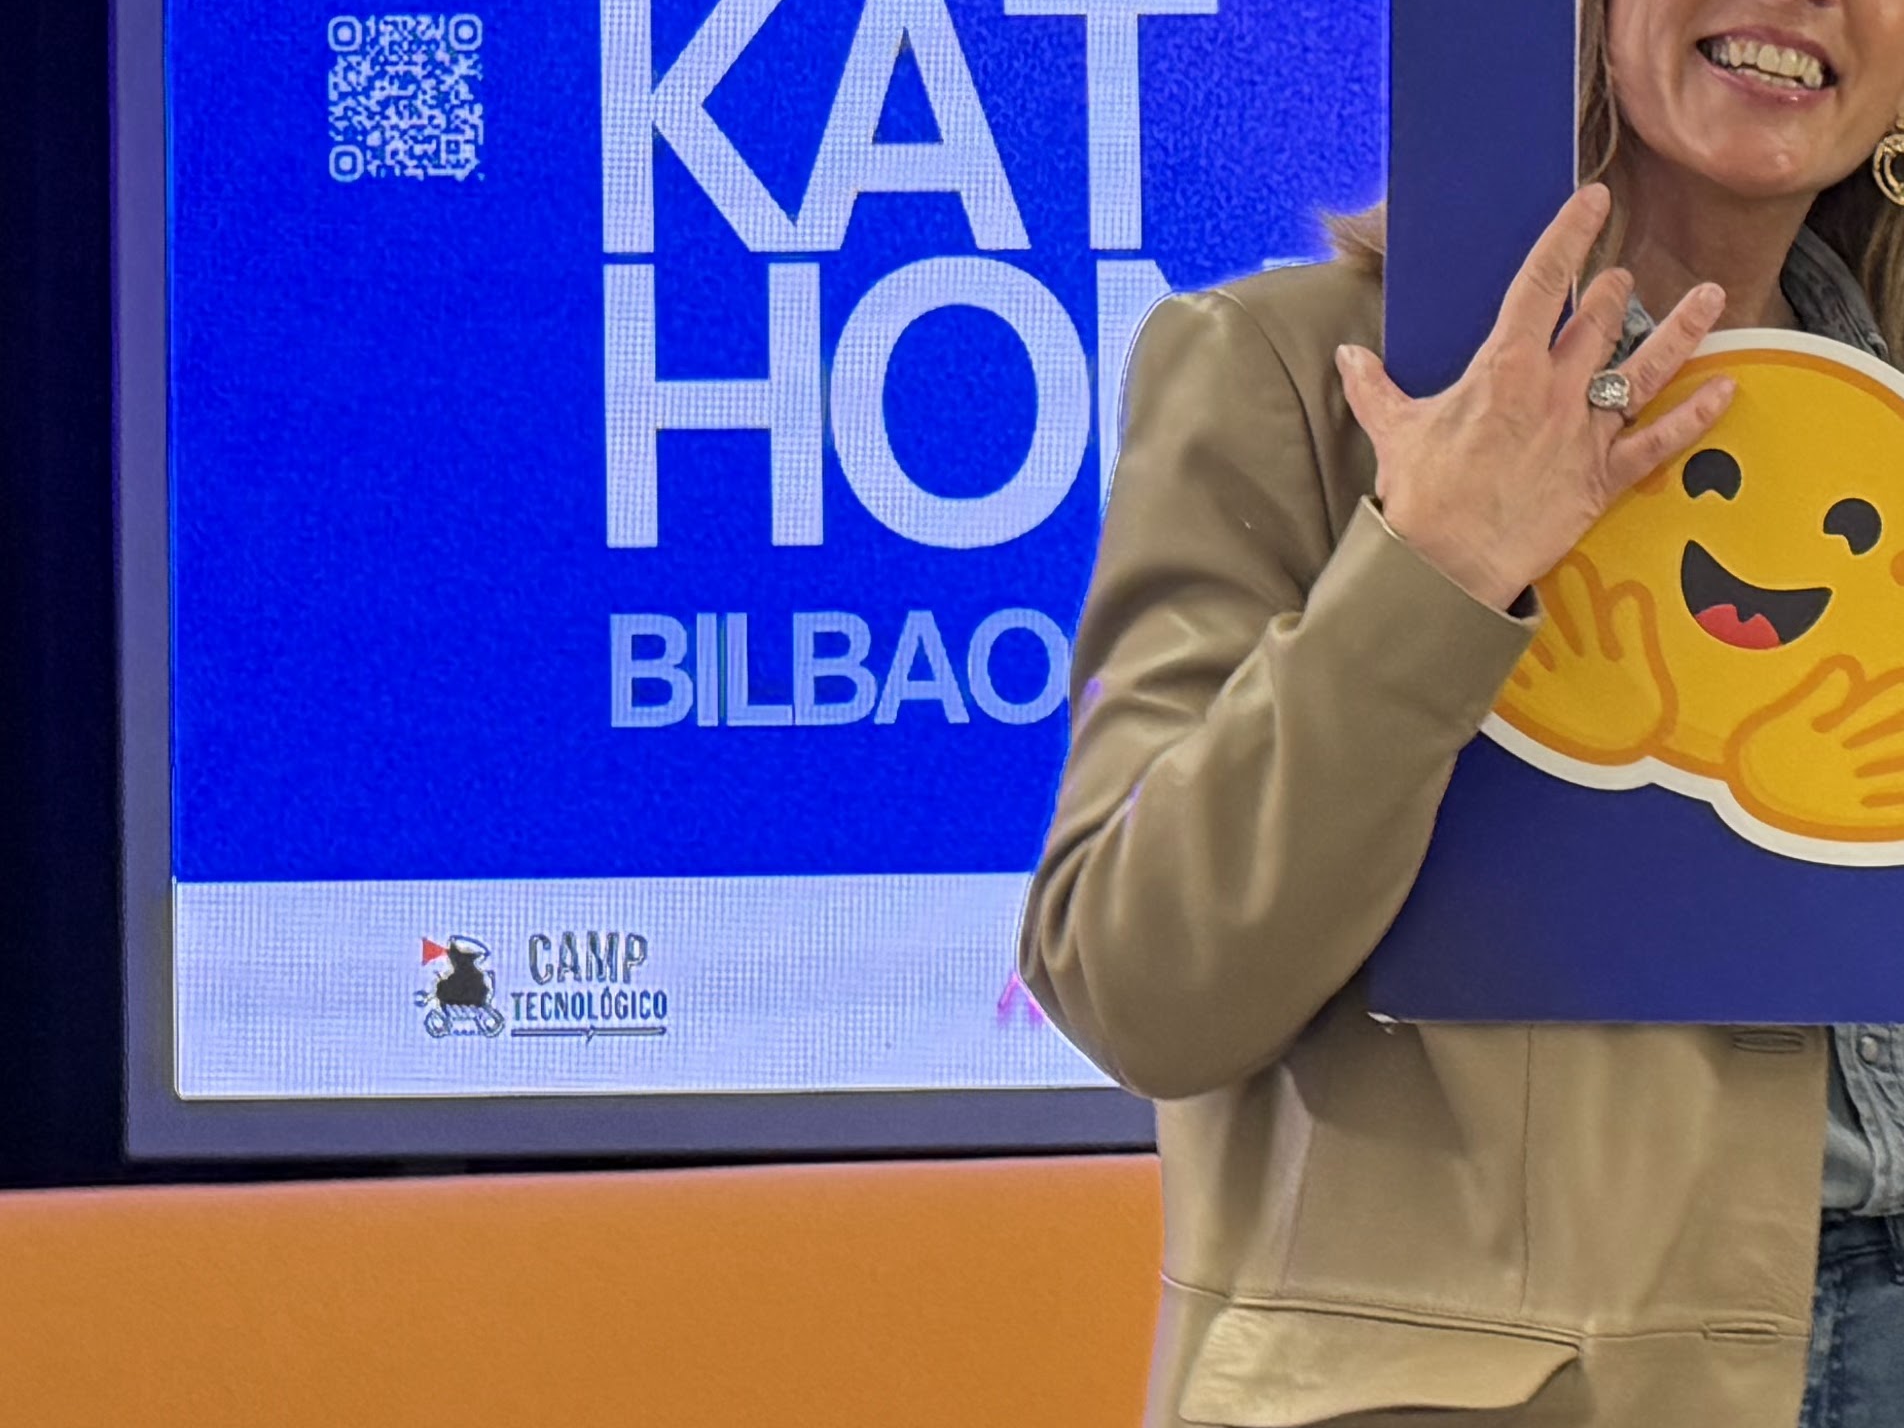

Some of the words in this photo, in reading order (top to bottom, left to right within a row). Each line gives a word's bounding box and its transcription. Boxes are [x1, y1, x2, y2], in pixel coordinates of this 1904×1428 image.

[603, 256, 1318, 549] HO
[610, 606, 1070, 727] BILBAO
[528, 931, 649, 986] CAMP
[510, 984, 668, 1022] TECNOLÓGICO
